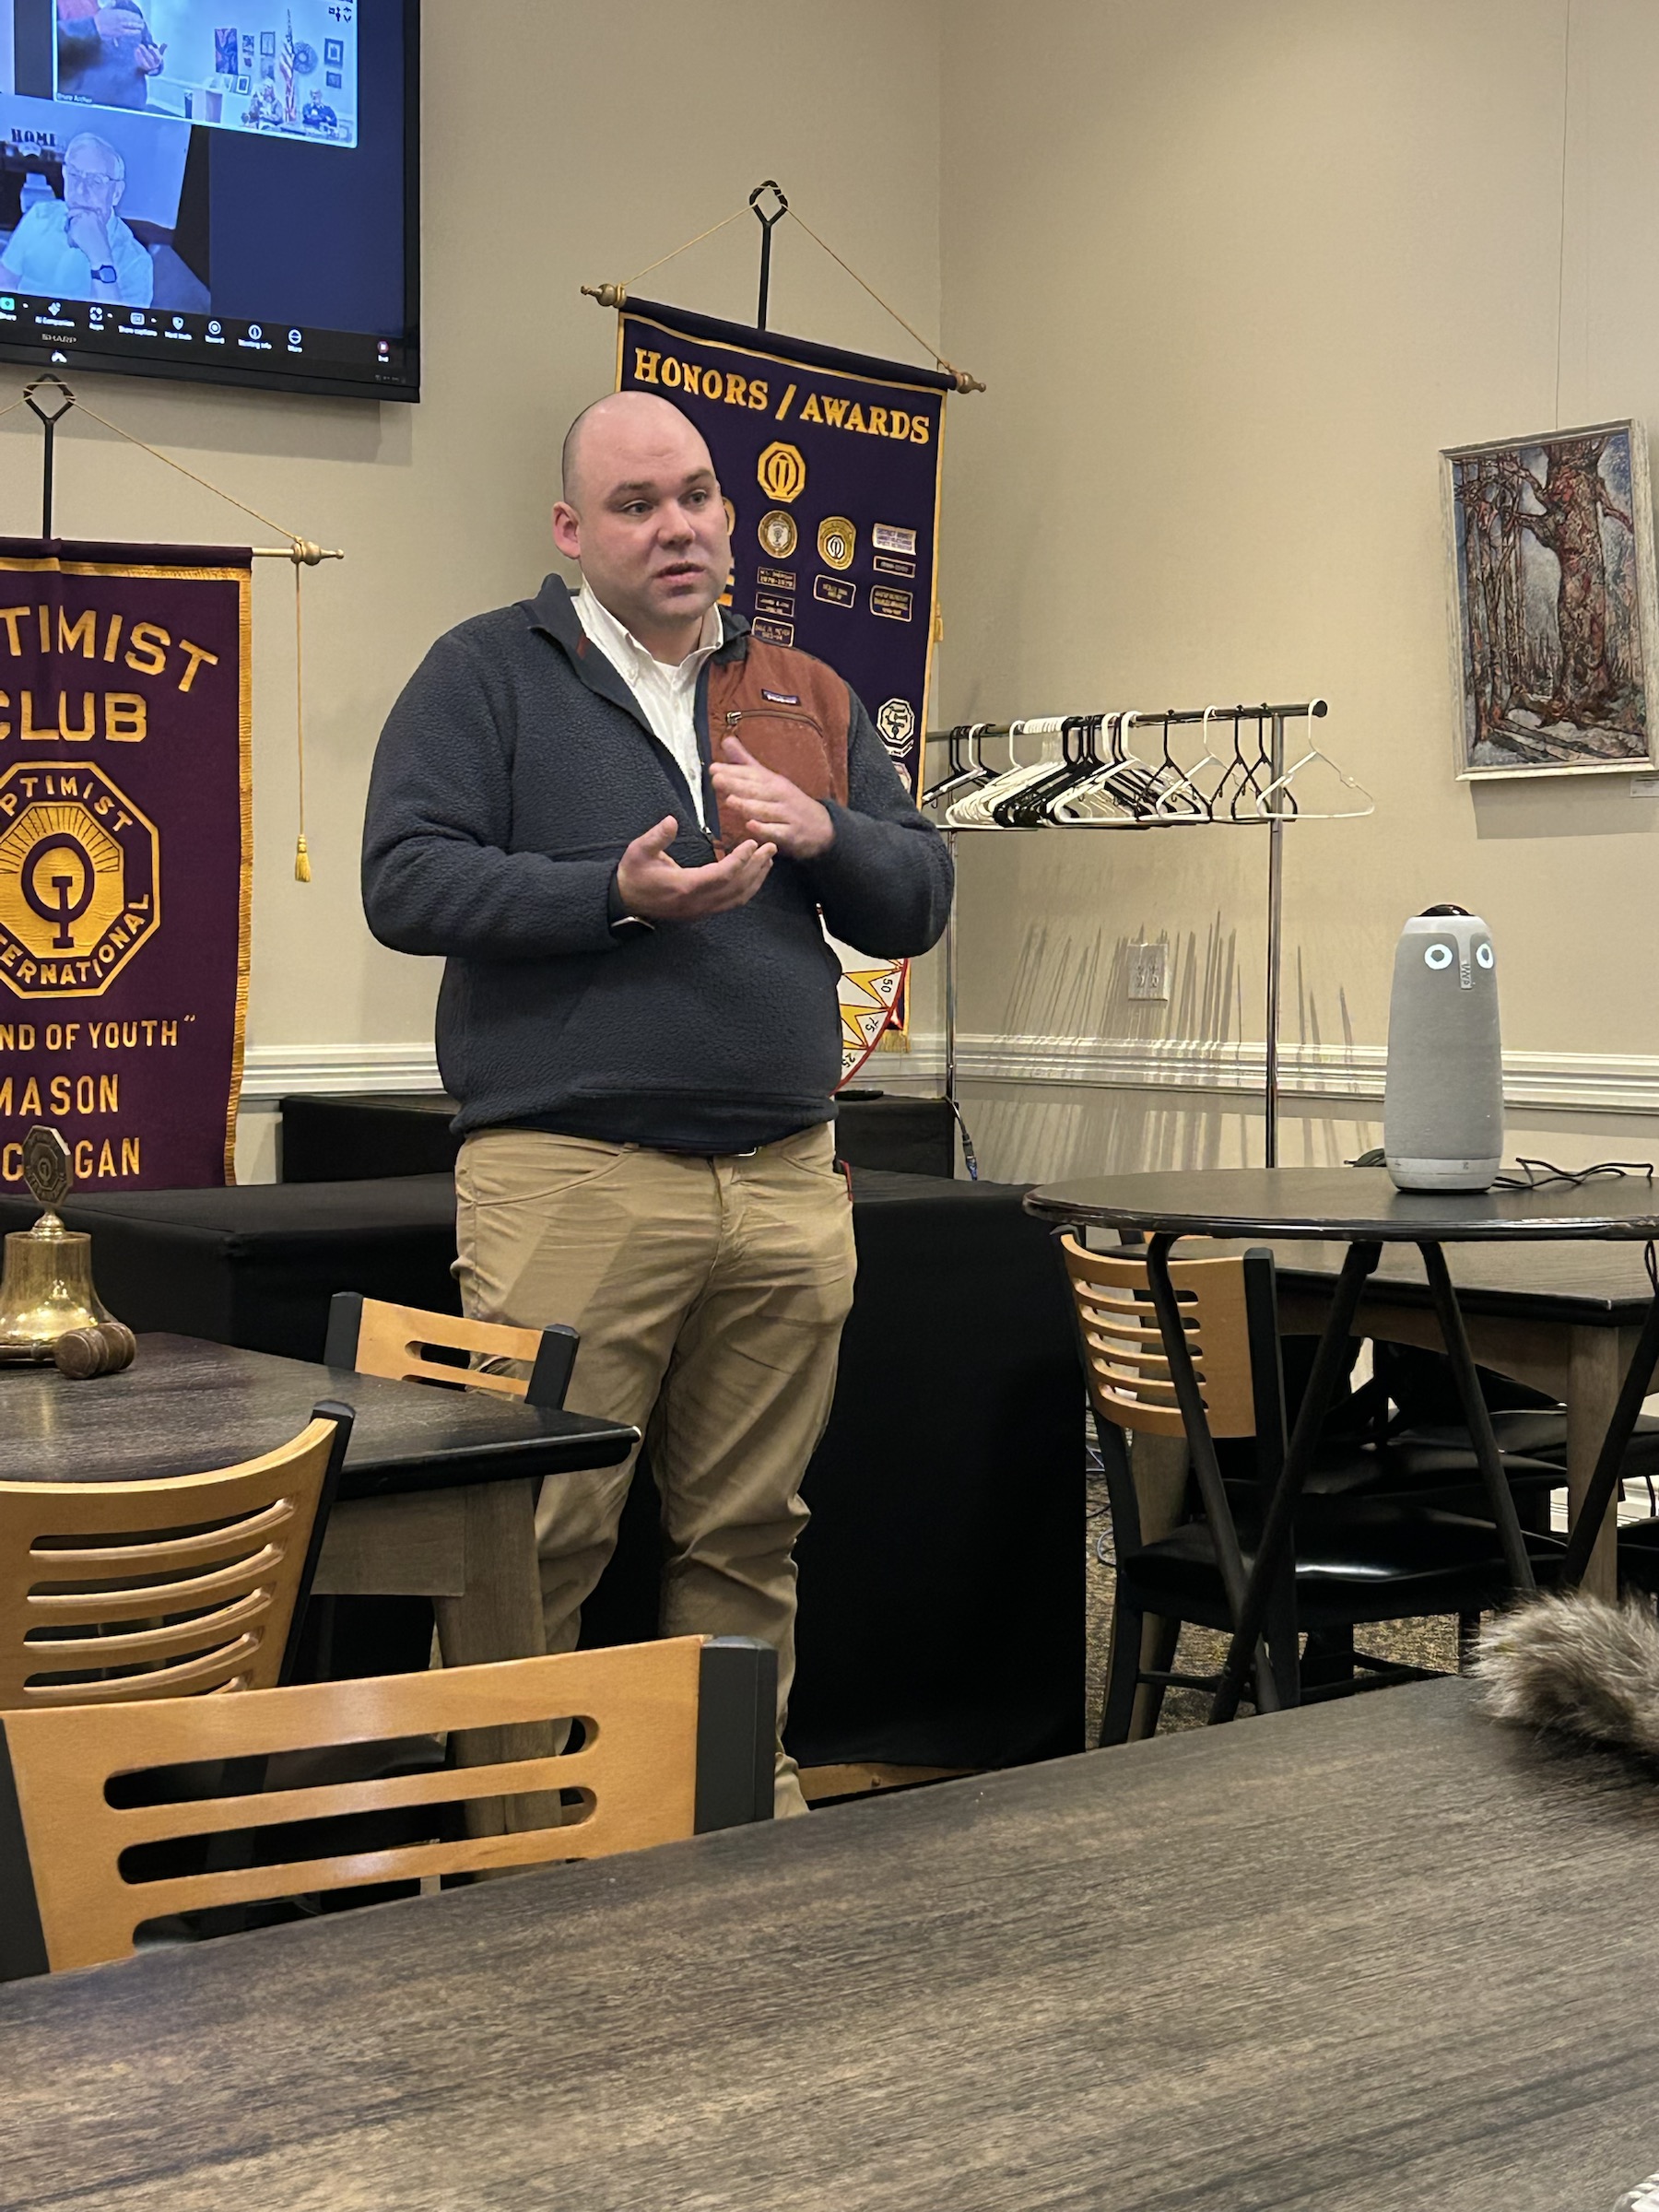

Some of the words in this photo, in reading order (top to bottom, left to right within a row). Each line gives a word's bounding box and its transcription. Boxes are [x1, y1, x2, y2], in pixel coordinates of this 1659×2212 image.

[41, 333, 77, 344] SHARP
[633, 347, 769, 411] HONORS
[775, 383, 797, 421] /
[799, 393, 930, 445] AWARDS
[0, 893, 149, 985] ERNATIONAL
[880, 977, 893, 994] 50
[46, 1022, 81, 1051] OF
[865, 1017, 879, 1033] 75
[841, 1053, 856, 1068] 25
[2, 1137, 140, 1182] CGAN
